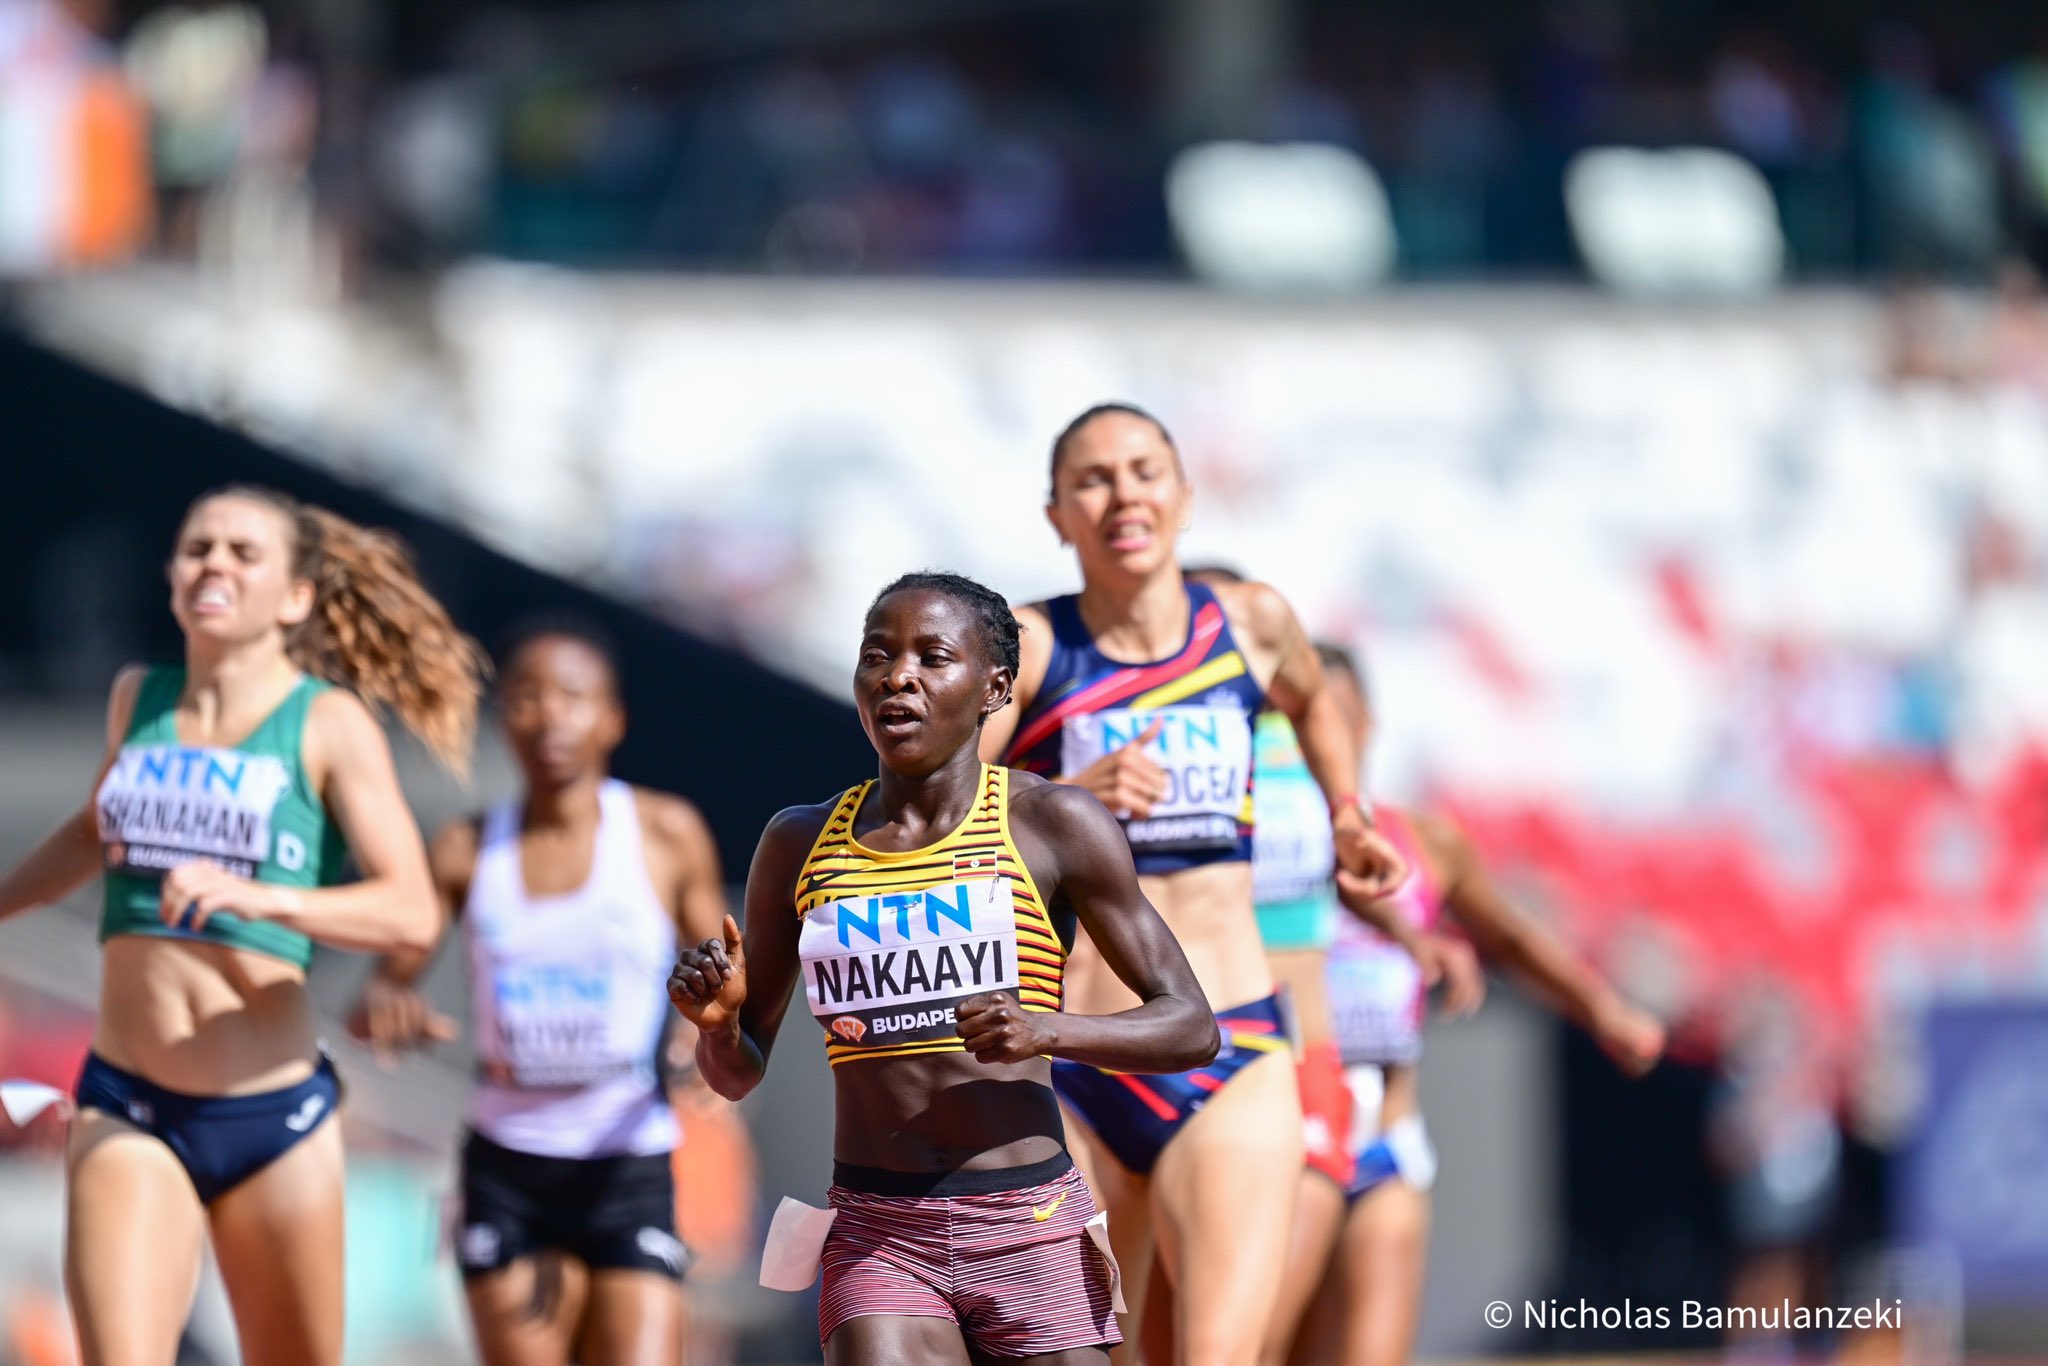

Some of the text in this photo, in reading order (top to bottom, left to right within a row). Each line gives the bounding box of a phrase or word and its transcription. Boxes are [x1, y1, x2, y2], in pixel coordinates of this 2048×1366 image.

[1102, 713, 1220, 753] NTN
[136, 749, 246, 795] NTN
[1162, 764, 1237, 806] OCEA
[100, 794, 258, 851] SHANAHAN
[837, 884, 972, 950] NTN
[813, 939, 1005, 1005] NAKAAYI
[872, 1007, 957, 1035] BUDAPE
